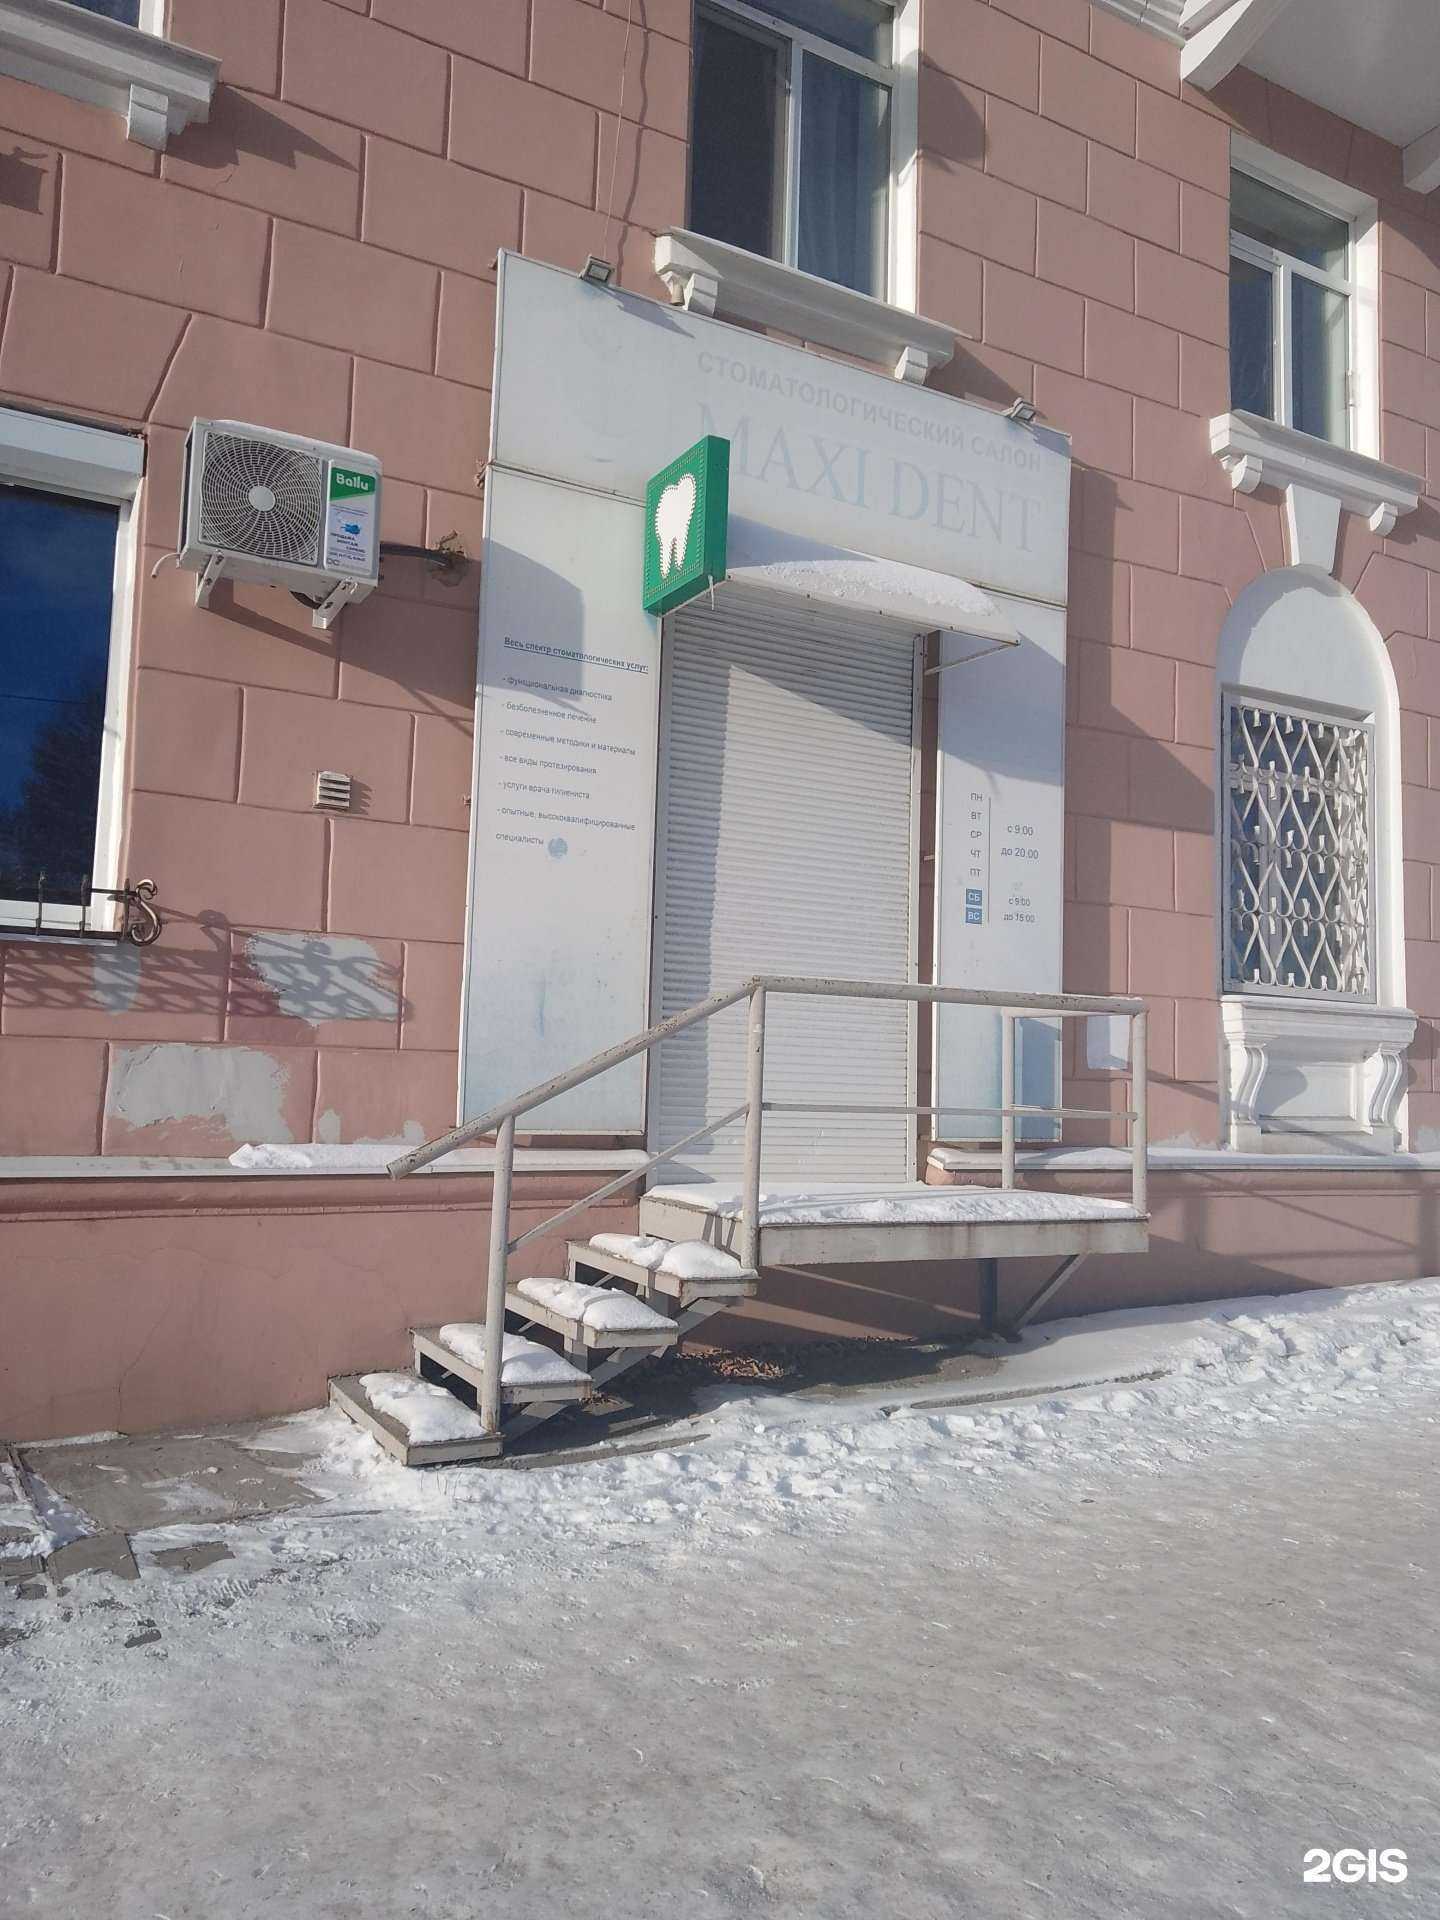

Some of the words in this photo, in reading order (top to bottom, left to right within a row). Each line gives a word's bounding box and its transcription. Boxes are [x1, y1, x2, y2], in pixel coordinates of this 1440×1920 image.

[696, 350, 967, 450] СТОМАТОЛОГИЧЕСКИЙ
[970, 436, 1042, 473] САЛОН
[335, 472, 369, 491] Ballu
[696, 400, 873, 510] MAXI
[887, 454, 1042, 553] DENT
[503, 637, 523, 648] Весь
[525, 641, 551, 654] спектр
[553, 647, 625, 668] стоматологических
[627, 660, 648, 673] услуг:
[507, 676, 568, 693] функциональная
[569, 687, 612, 701] диагностика
[506, 701, 566, 719] безболезненное
[567, 712, 597, 724] лечение
[505, 729, 555, 744] современные
[556, 737, 590, 749] методики
[597, 744, 636, 756] материалы
[504, 755, 517, 763] все
[518, 757, 538, 767] виды
[539, 760, 597, 775] протезирования
[503, 780, 528, 791] услуги
[528, 784, 550, 794] врача
[551, 787, 590, 799] гигиениста
[970, 792, 983, 802] ПН
[538, 812, 636, 831] высококвалифицированные
[970, 811, 982, 820] ВТ
[495, 832, 544, 845] специалисты
[970, 830, 982, 839] СР
[970, 849, 981, 858] ЧТ
[1000, 847, 1013, 857] до
[970, 868, 982, 877] ПТ
[968, 892, 980, 902] СБ
[967, 911, 980, 921] ВС
[1003, 913, 1013, 921] до
